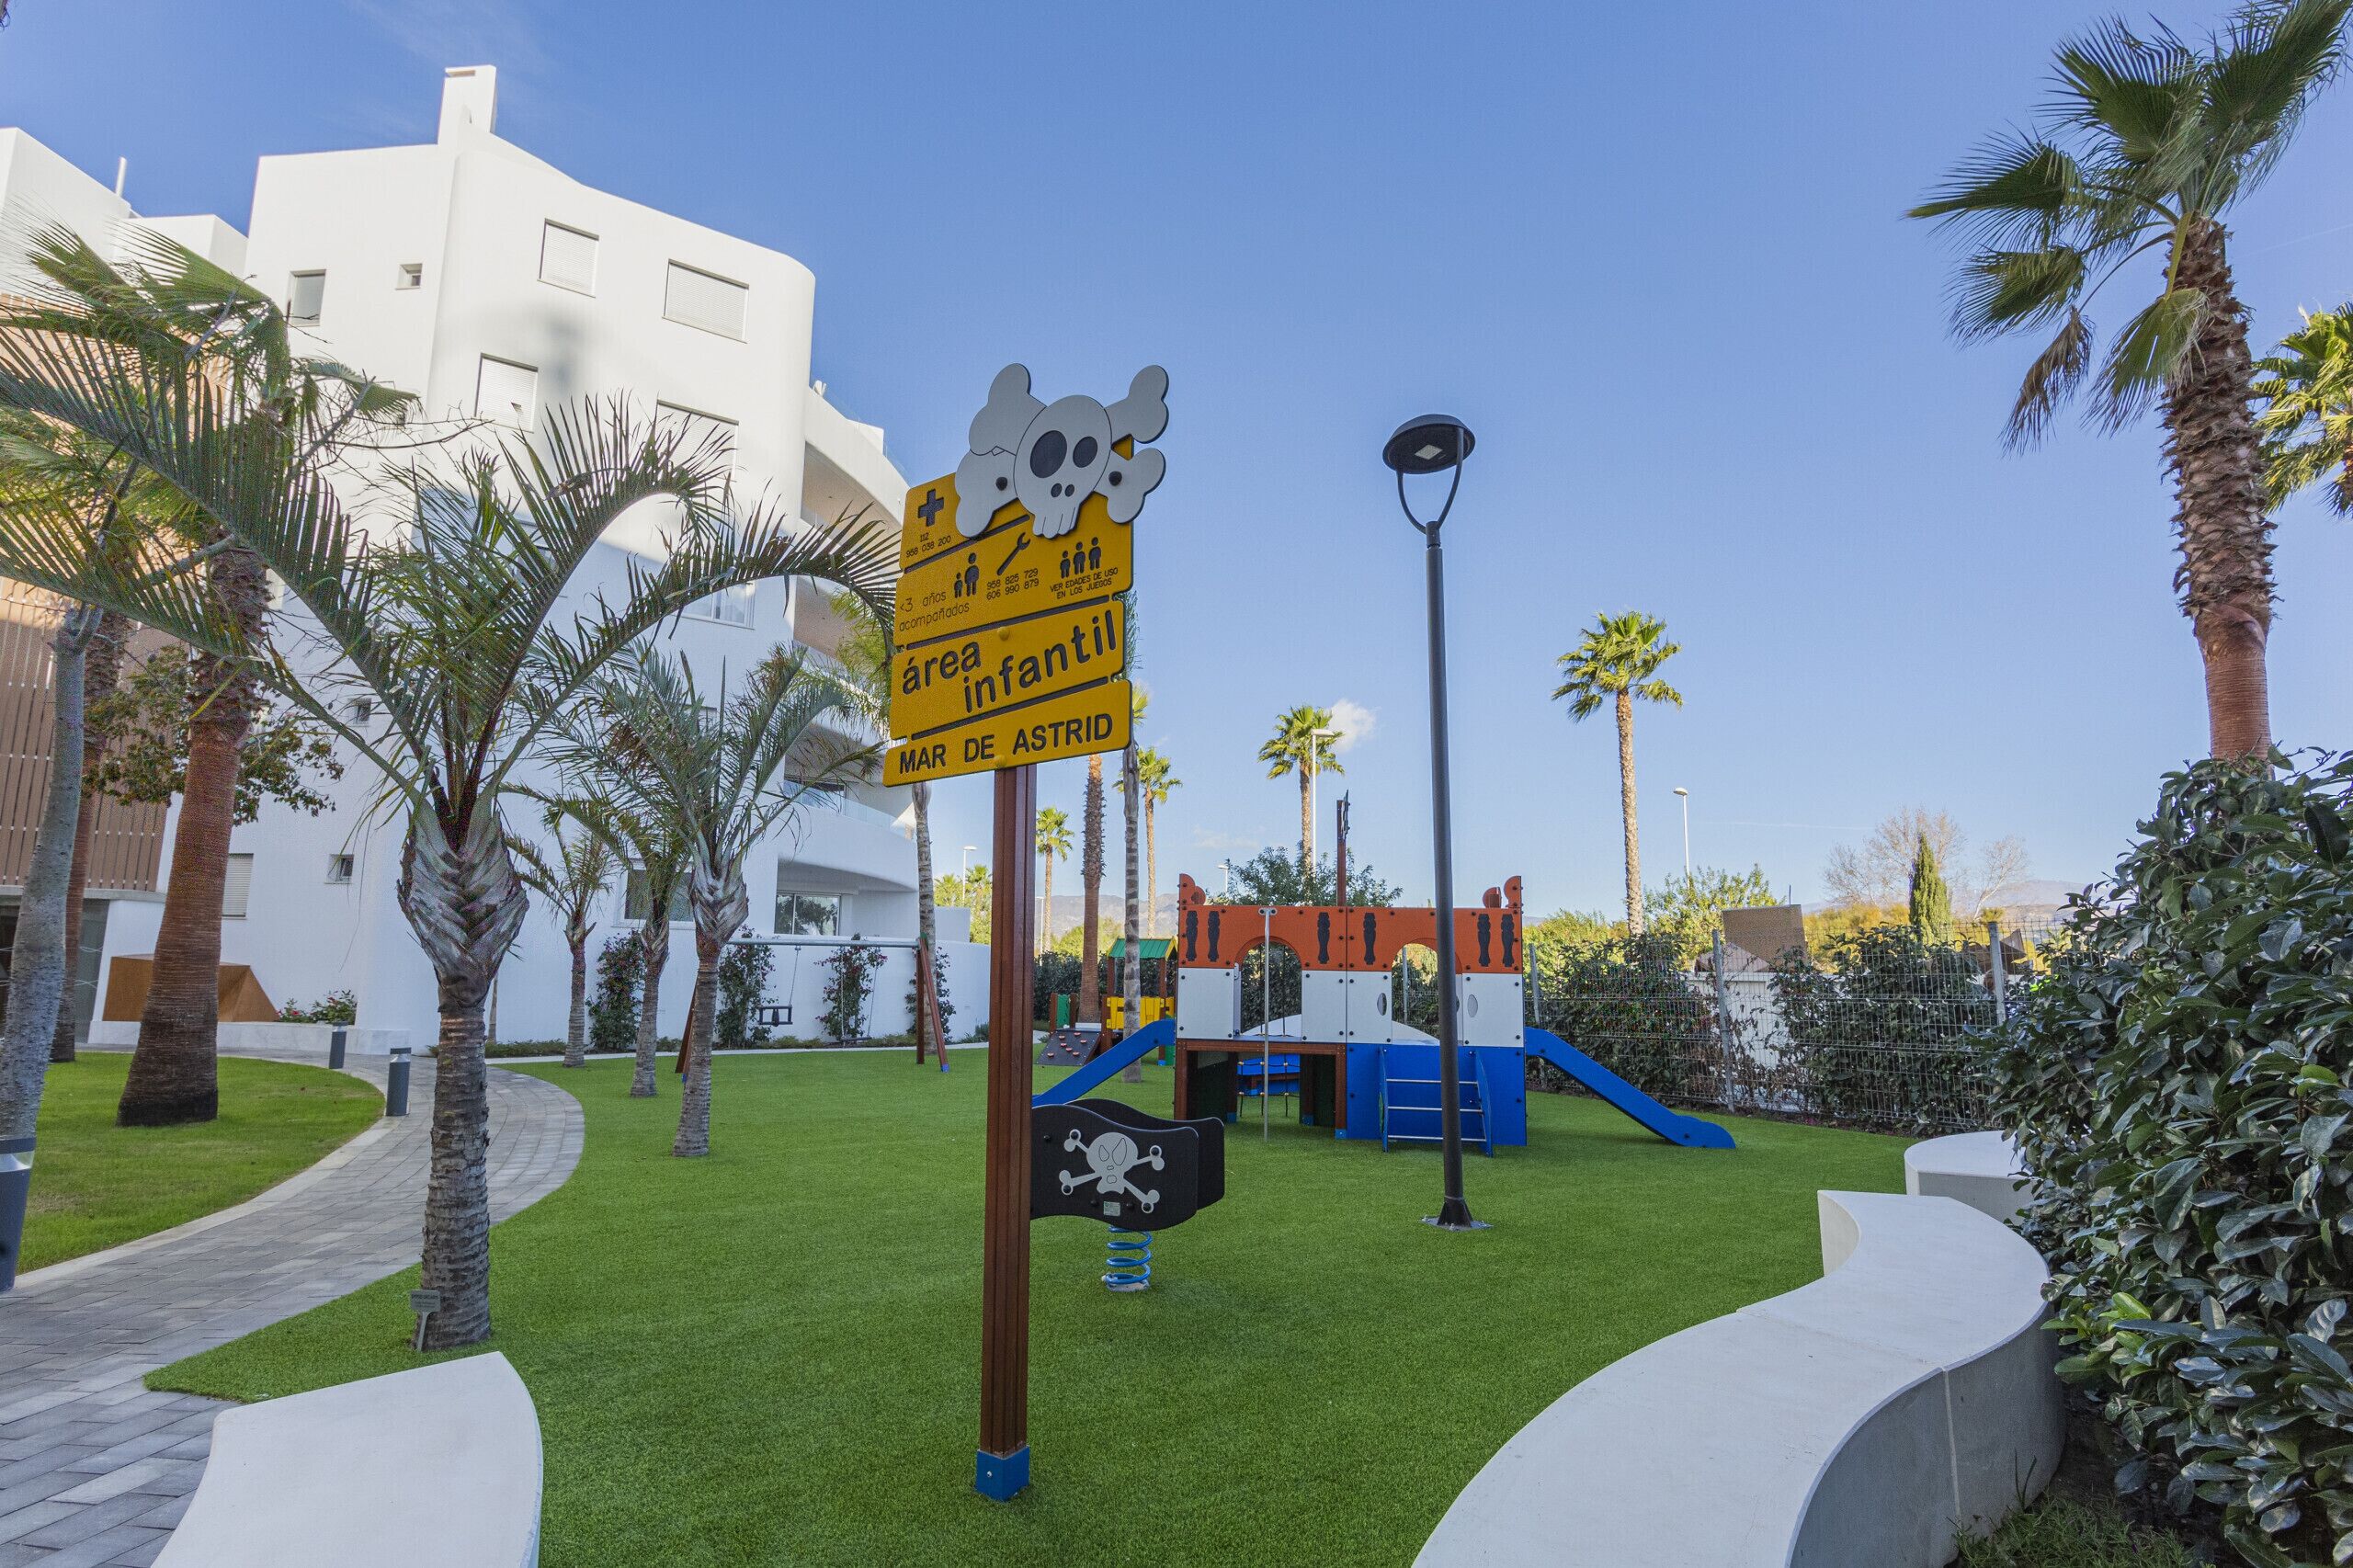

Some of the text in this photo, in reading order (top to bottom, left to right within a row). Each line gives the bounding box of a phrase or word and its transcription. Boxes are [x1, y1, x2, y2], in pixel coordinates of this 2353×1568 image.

[920, 533, 929, 542] 112
[938, 535, 951, 547] 200
[1006, 574, 1019, 585] 825
[1024, 568, 1039, 579] 729
[1050, 567, 1119, 592] VER EDADES DE USO
[922, 591, 947, 607] años
[987, 578, 1040, 600] 606 990 879
[1056, 577, 1112, 599] EN LOS JUEGOS
[899, 602, 970, 632] acompañados
[902, 642, 981, 696] área
[963, 609, 1117, 713] infantil
[899, 713, 1113, 774] MAR DE ASTRID
